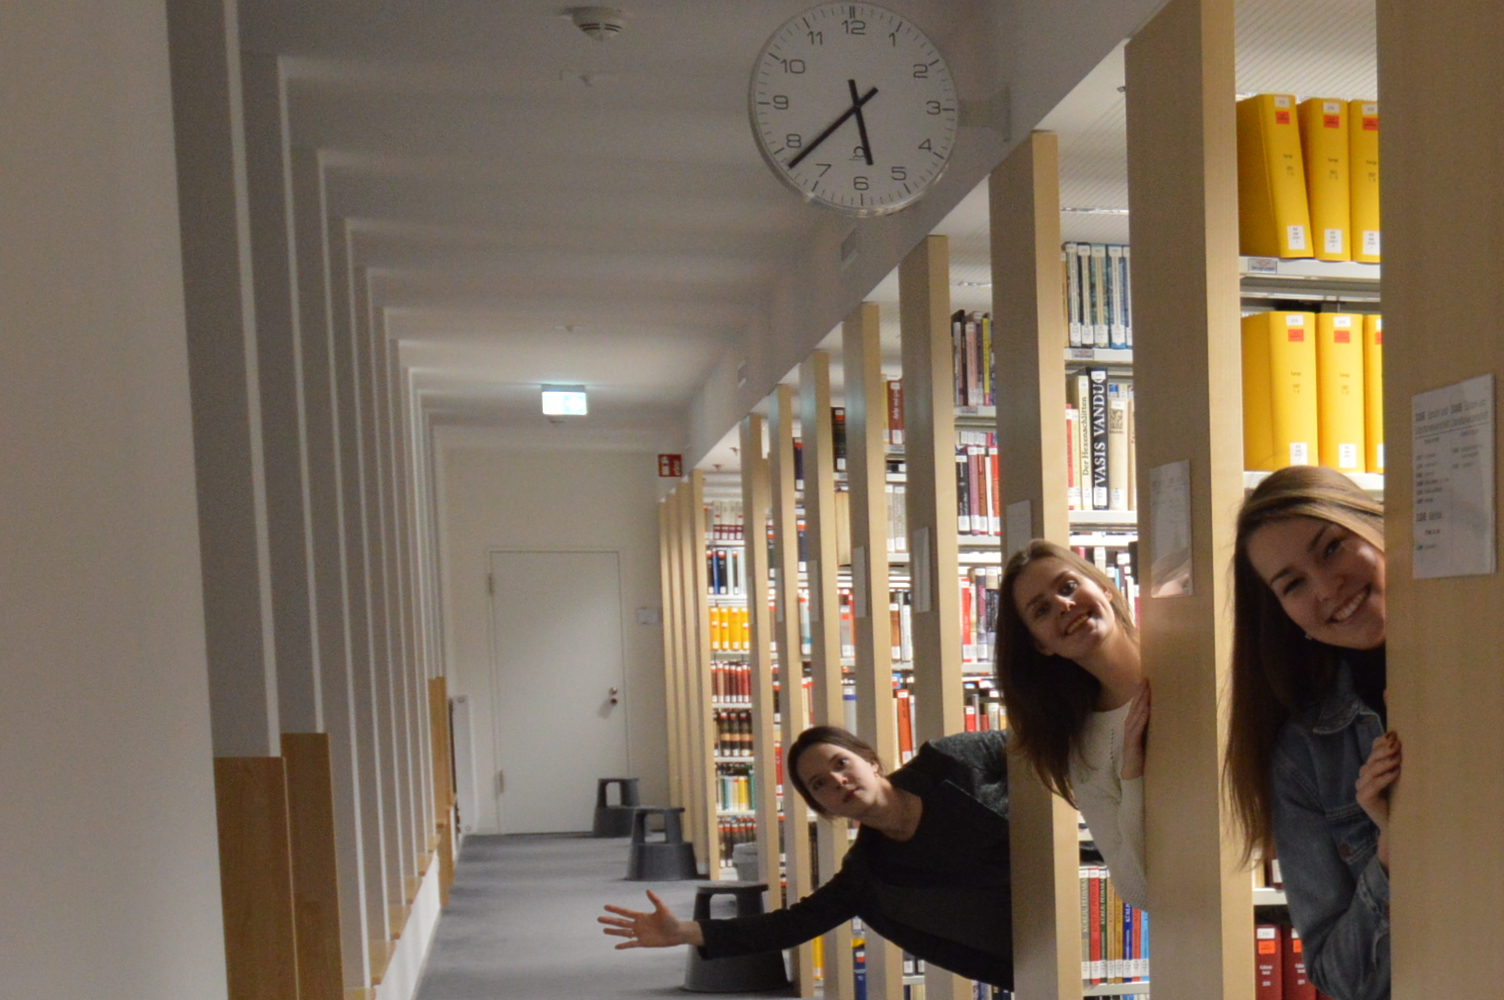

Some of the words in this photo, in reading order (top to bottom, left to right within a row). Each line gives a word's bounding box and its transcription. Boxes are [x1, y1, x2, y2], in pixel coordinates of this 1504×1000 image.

[841, 20, 866, 35] 12
[806, 31, 823, 45] 11
[888, 32, 896, 46] 1
[780, 59, 806, 74] 10
[913, 64, 928, 79] 2
[773, 95, 789, 110] 9
[926, 100, 941, 115] 3
[786, 133, 802, 148] 8
[918, 138, 932, 152] 4
[816, 163, 832, 177] 7
[891, 166, 907, 181] 5
[853, 176, 869, 191] 6
[1080, 396, 1089, 459] Hexenschlitten
